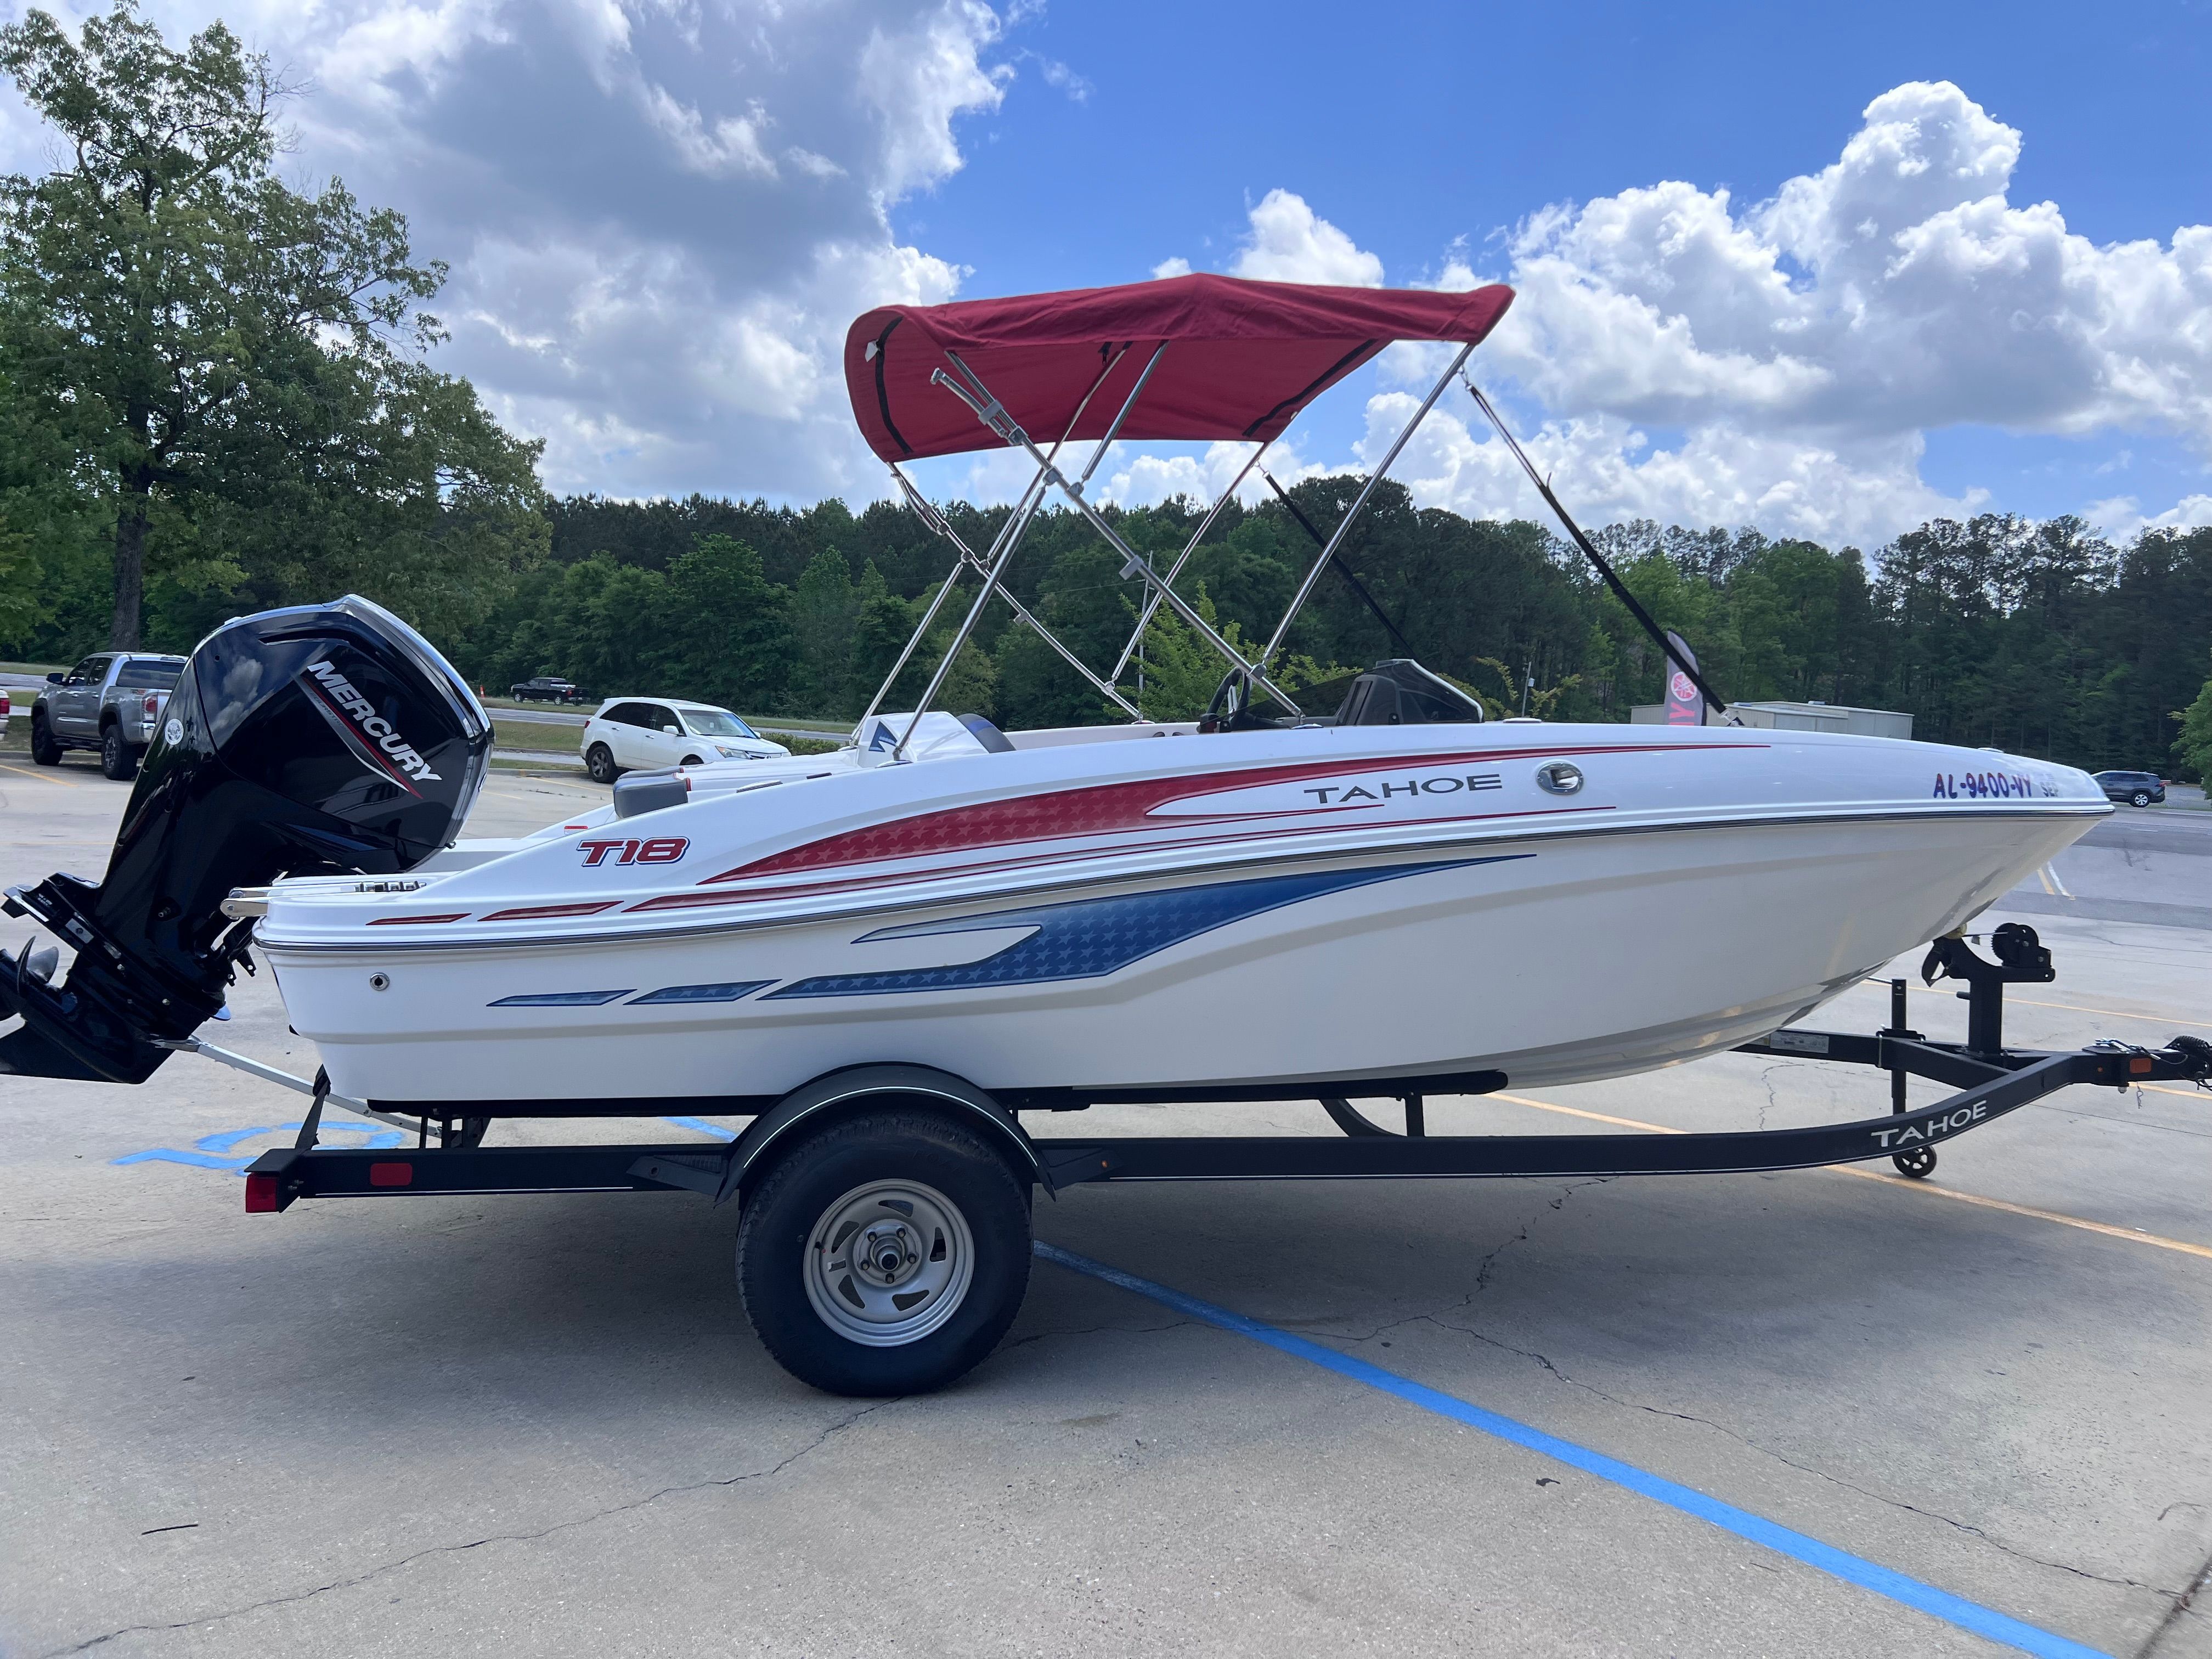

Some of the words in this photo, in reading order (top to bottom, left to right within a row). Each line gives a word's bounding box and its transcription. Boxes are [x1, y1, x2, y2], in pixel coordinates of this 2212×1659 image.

[307, 661, 442, 781] MERCURY
[1304, 774, 1503, 804] TAHOE
[577, 836, 690, 867] T18
[1871, 1100, 1987, 1147] TAHOE
